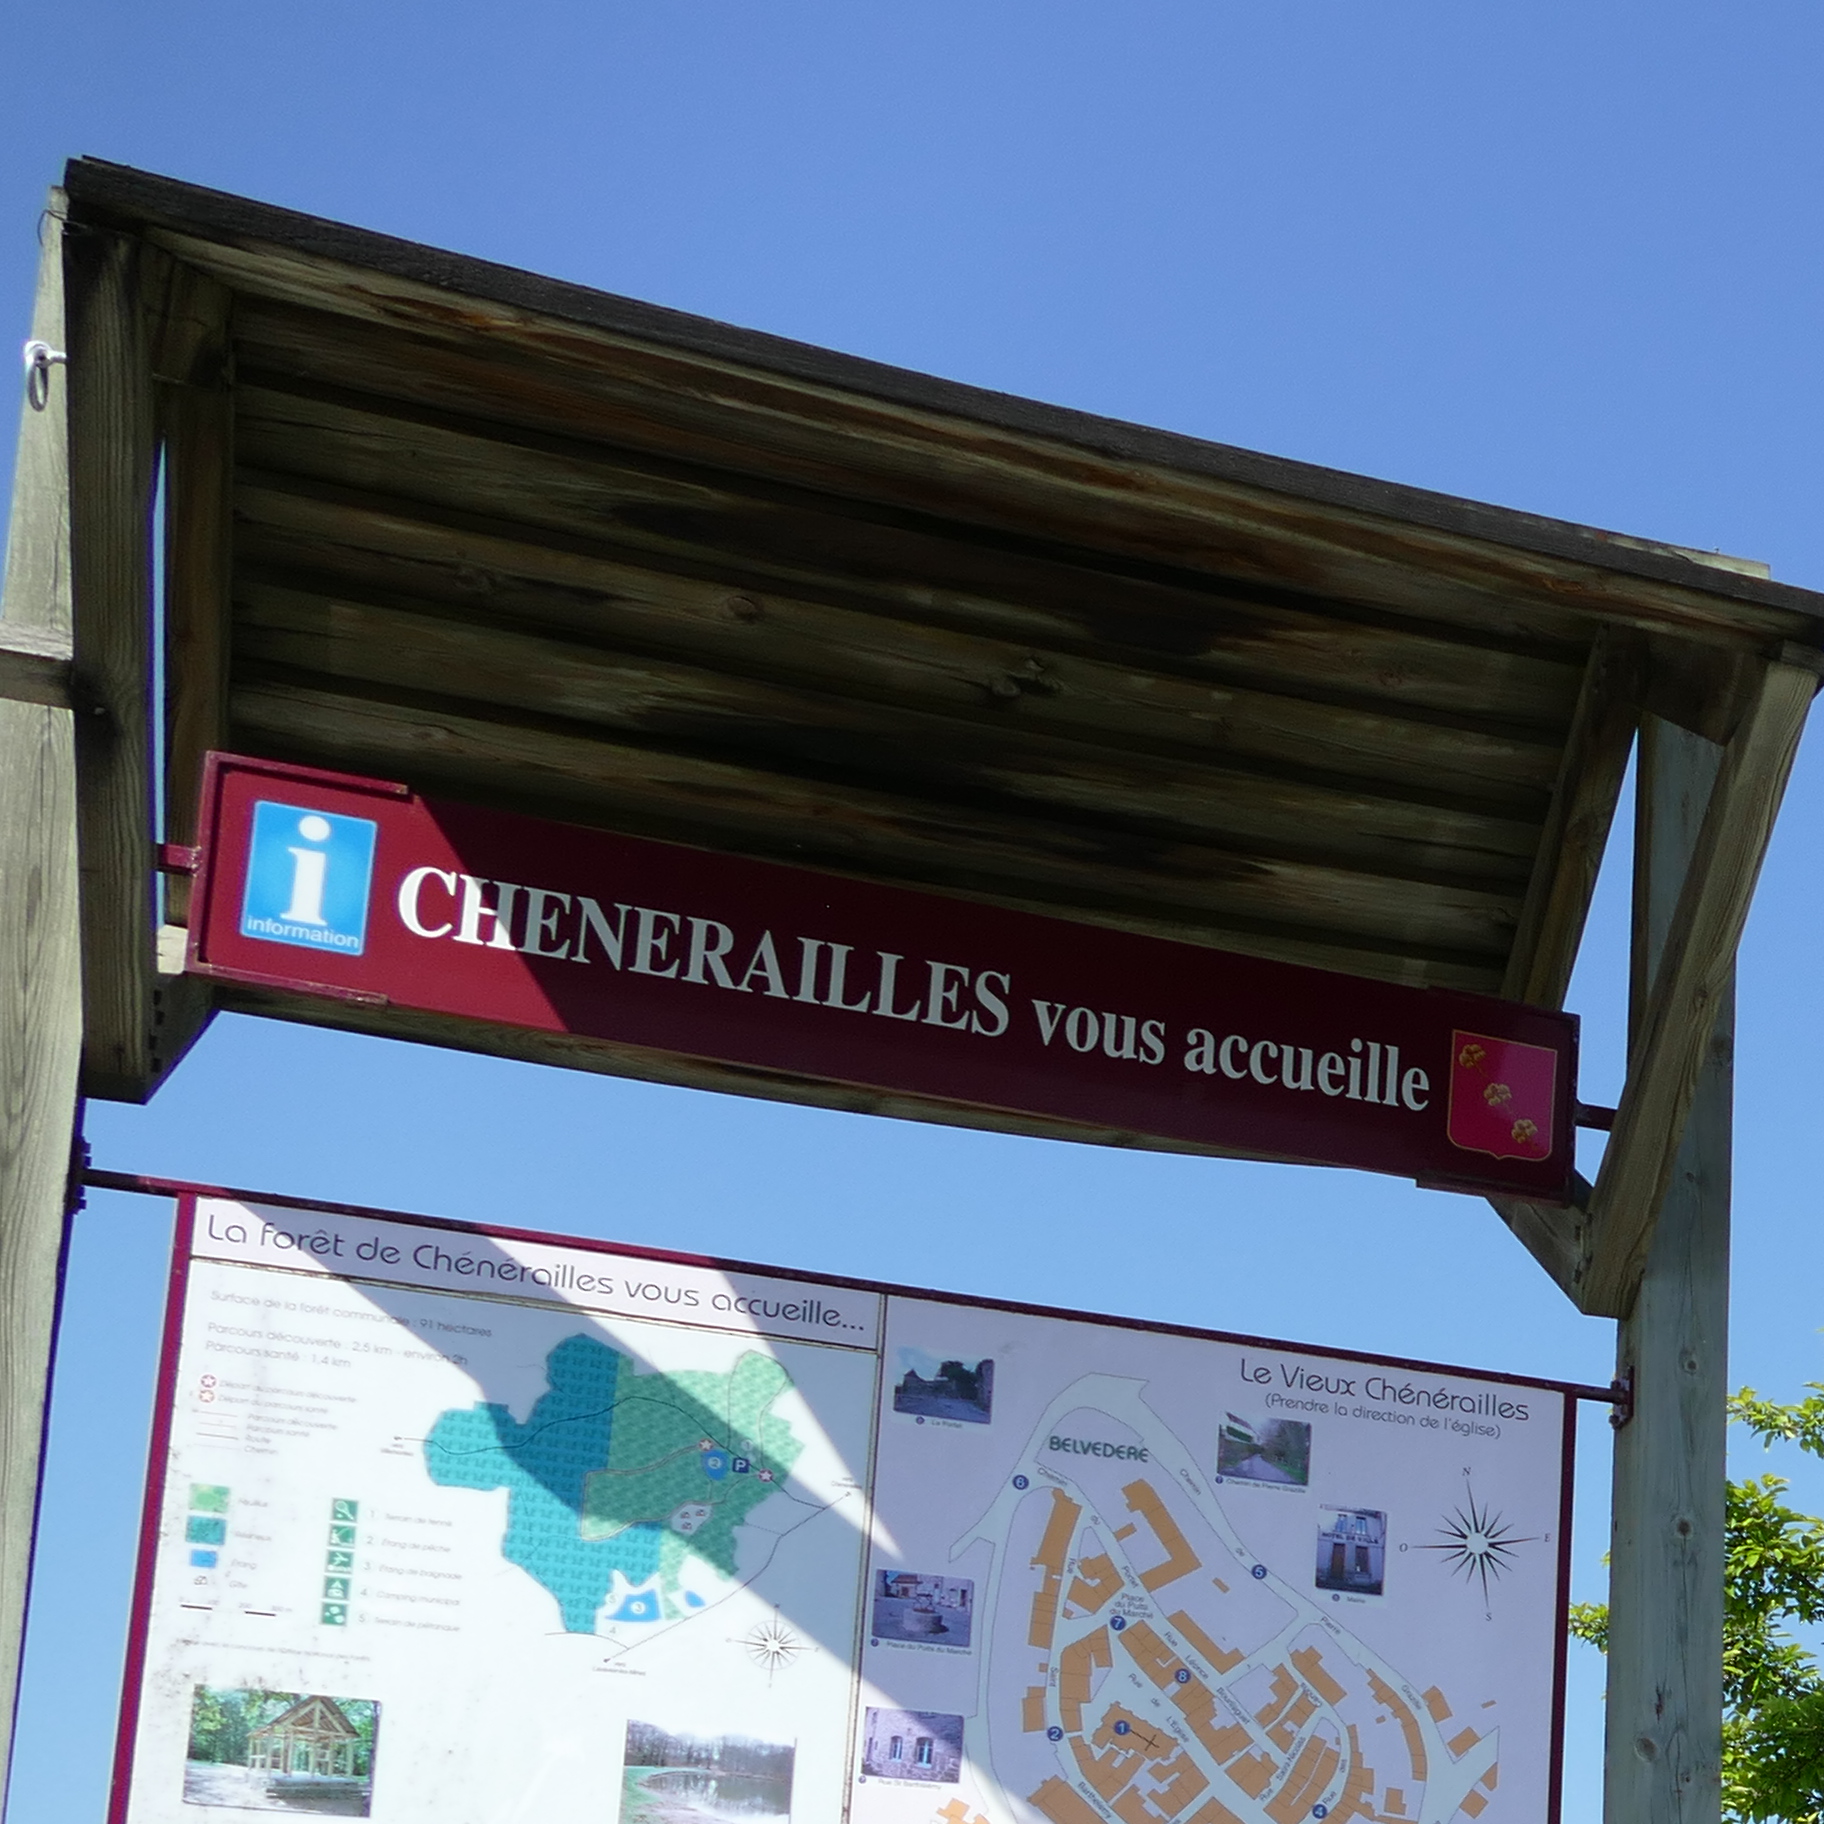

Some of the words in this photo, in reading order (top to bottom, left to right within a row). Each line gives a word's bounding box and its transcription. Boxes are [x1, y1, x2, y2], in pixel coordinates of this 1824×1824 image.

[246, 915, 360, 950] information
[399, 865, 1011, 1038] CHENERAILLES
[1031, 998, 1166, 1065] vous
[1183, 1027, 1430, 1112] accueille
[207, 1214, 248, 1244] La
[259, 1222, 345, 1258] forêt
[355, 1237, 400, 1265] de
[413, 1244, 614, 1295] Chénérailles
[624, 1280, 700, 1307] vous
[711, 1292, 865, 1332] accueille...
[210, 1290, 261, 1307] Surface
[264, 1295, 281, 1308] de
[298, 1299, 330, 1316] forêt
[419, 1317, 434, 1332] 91
[436, 1320, 493, 1338] hectares
[205, 1339, 259, 1358] Parcours
[331, 1354, 351, 1368] km
[208, 1321, 263, 1340] Parcours
[266, 1327, 342, 1350] découverte
[373, 1343, 393, 1356] km
[1241, 1358, 1272, 1385] Le
[1279, 1363, 1356, 1398] Vieux
[1365, 1376, 1531, 1421] Chénérailles
[1265, 1391, 1330, 1415] (Prendre
[1333, 1401, 1348, 1417] la
[1351, 1404, 1416, 1427] direction
[1419, 1413, 1440, 1429] de
[1048, 1435, 1150, 1464] BELVEDERE
[1461, 1467, 1472, 1477] N
[1485, 1612, 1493, 1622] S
